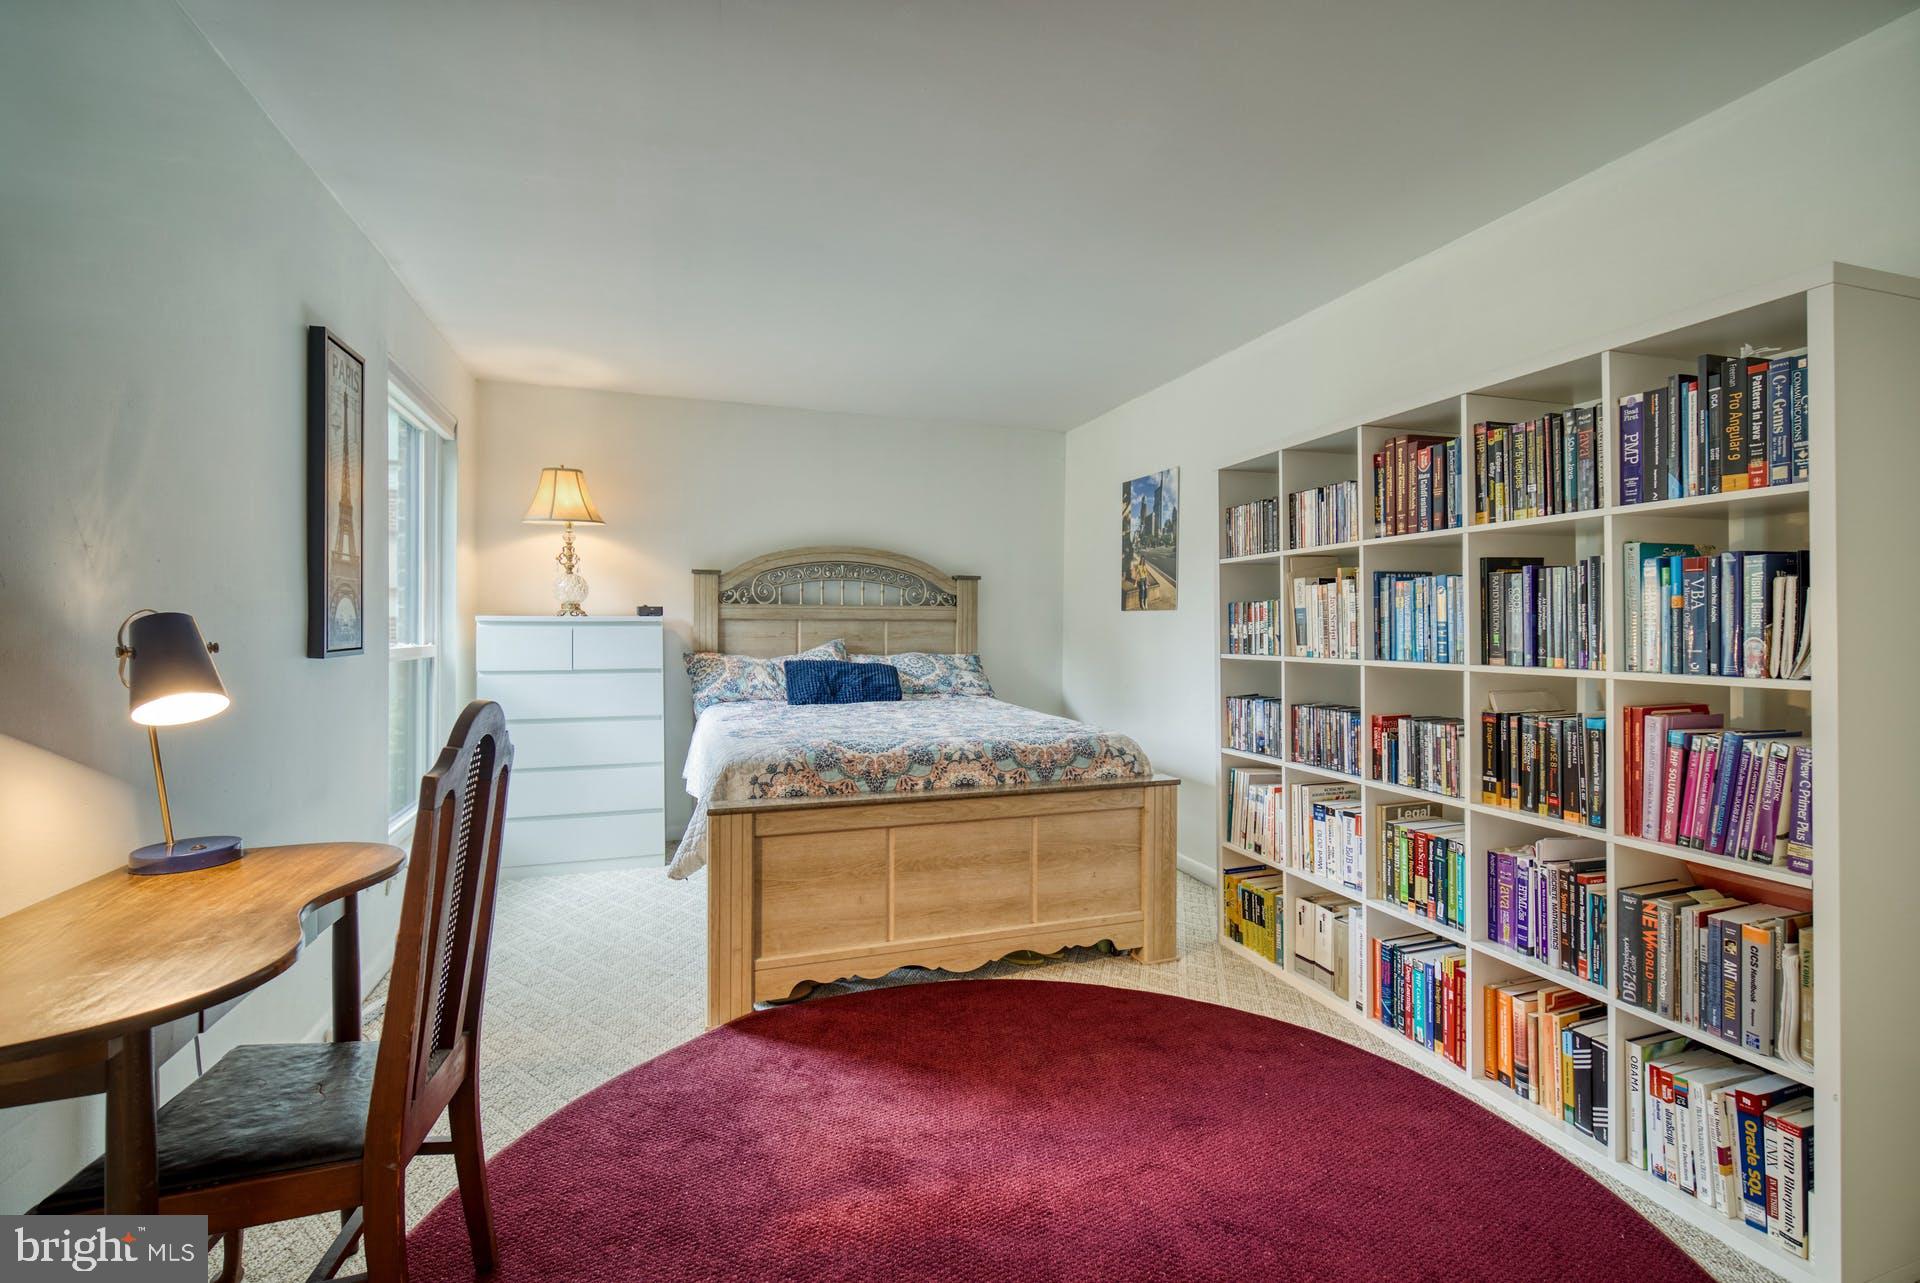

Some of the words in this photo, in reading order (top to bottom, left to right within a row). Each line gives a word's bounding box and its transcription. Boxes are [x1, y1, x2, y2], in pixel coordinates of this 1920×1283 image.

[1729, 391, 1743, 409] Pro
[1751, 375, 1763, 410] Patterns
[1772, 375, 1787, 397] C++
[1772, 398, 1787, 434] Gems
[1794, 372, 1802, 441] COMMUNICATIONS
[1578, 429, 1594, 457] Java
[1726, 412, 1744, 451] Angular
[1751, 421, 1763, 440] Java
[1624, 432, 1639, 464] PMP
[1691, 577, 1705, 610] VBA
[1666, 768, 1677, 813] SOLUTIONS
[1773, 763, 1785, 802] Enterprise
[1398, 804, 1431, 820] Legal
[1797, 789, 1809, 820] Primer
[1796, 821, 1807, 840] Plus
[1417, 837, 1426, 876] JavaScript
[1499, 884, 1513, 909] Java
[1519, 884, 1527, 910] HTML
[1551, 902, 1559, 950] MATHEMATICS
[1723, 960, 1737, 981] ANT
[1750, 945, 1759, 968] CICS
[1622, 972, 1637, 1002] DB2
[1750, 968, 1758, 1003] Handbook
[1724, 989, 1735, 1019] ACTION
[1630, 1056, 1638, 1092] OBAMA
[1665, 1109, 1675, 1146] JavaScript
[1744, 1120, 1760, 1165] Oracle
[1766, 1139, 1778, 1168] UNIX
[1783, 1136, 1794, 1174] TCP/IP
[1747, 1168, 1761, 1197] SQL
[1782, 1175, 1795, 1234] Blueprints
